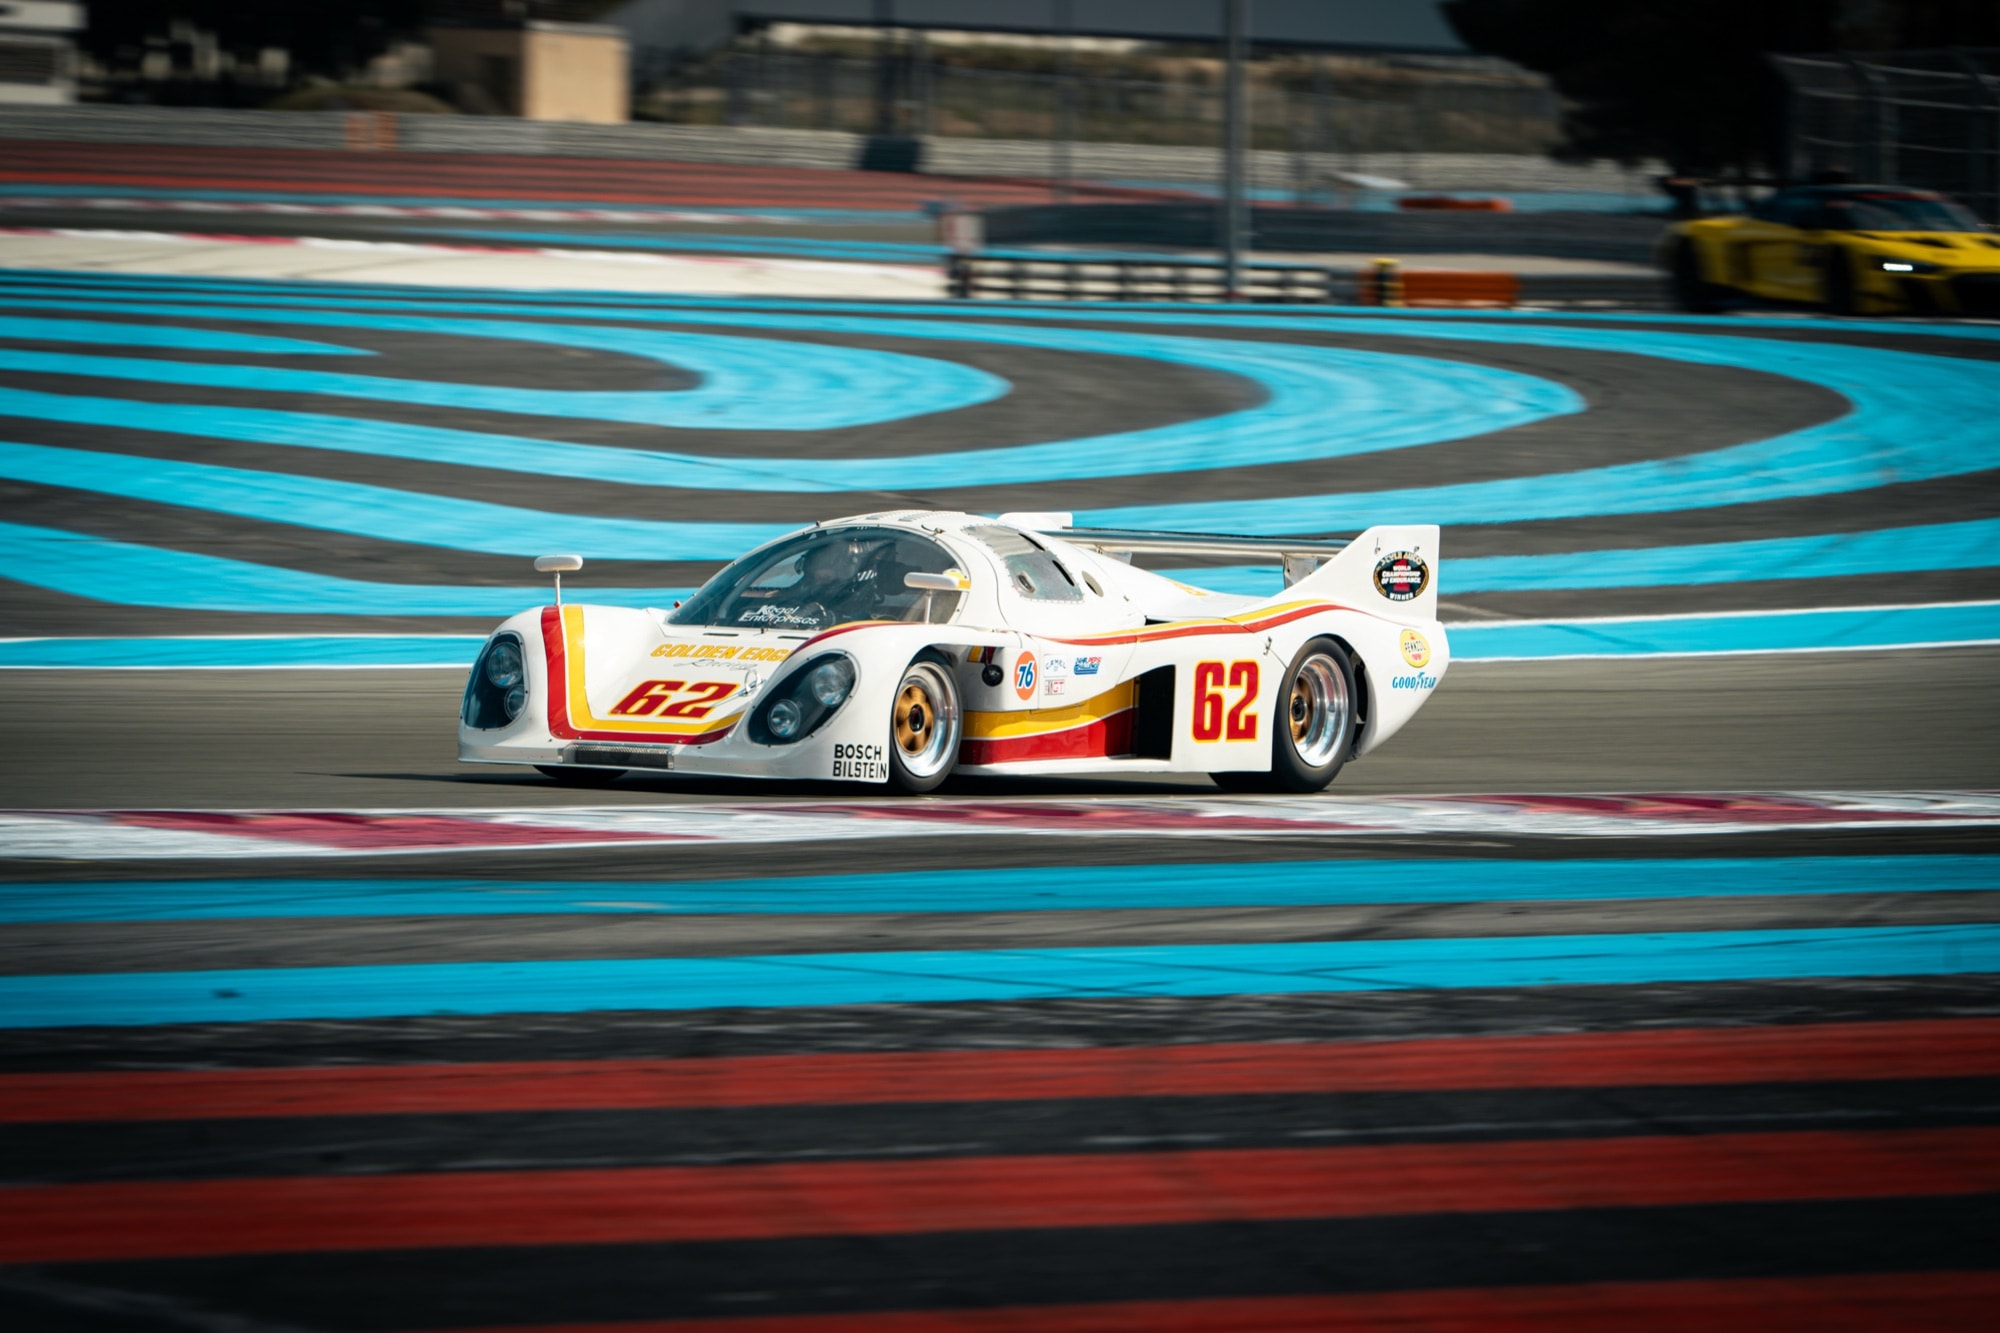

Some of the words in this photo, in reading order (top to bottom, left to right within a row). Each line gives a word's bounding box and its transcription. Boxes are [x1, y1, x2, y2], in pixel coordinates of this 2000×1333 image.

[1381, 570, 1421, 578] CHAMPIONSHIP
[1389, 592, 1414, 601] WINNER
[738, 611, 820, 625] Enterprises
[650, 643, 743, 660] GOLDEN
[738, 647, 795, 663] EAG
[1045, 658, 1066, 670] CAMEL
[1018, 662, 1034, 688] 76
[1392, 671, 1436, 691] GOODYEAR
[608, 679, 741, 719] 62
[1192, 659, 1260, 743] 62
[834, 744, 882, 761] BOSCH
[832, 760, 887, 779] BILSTEIN
